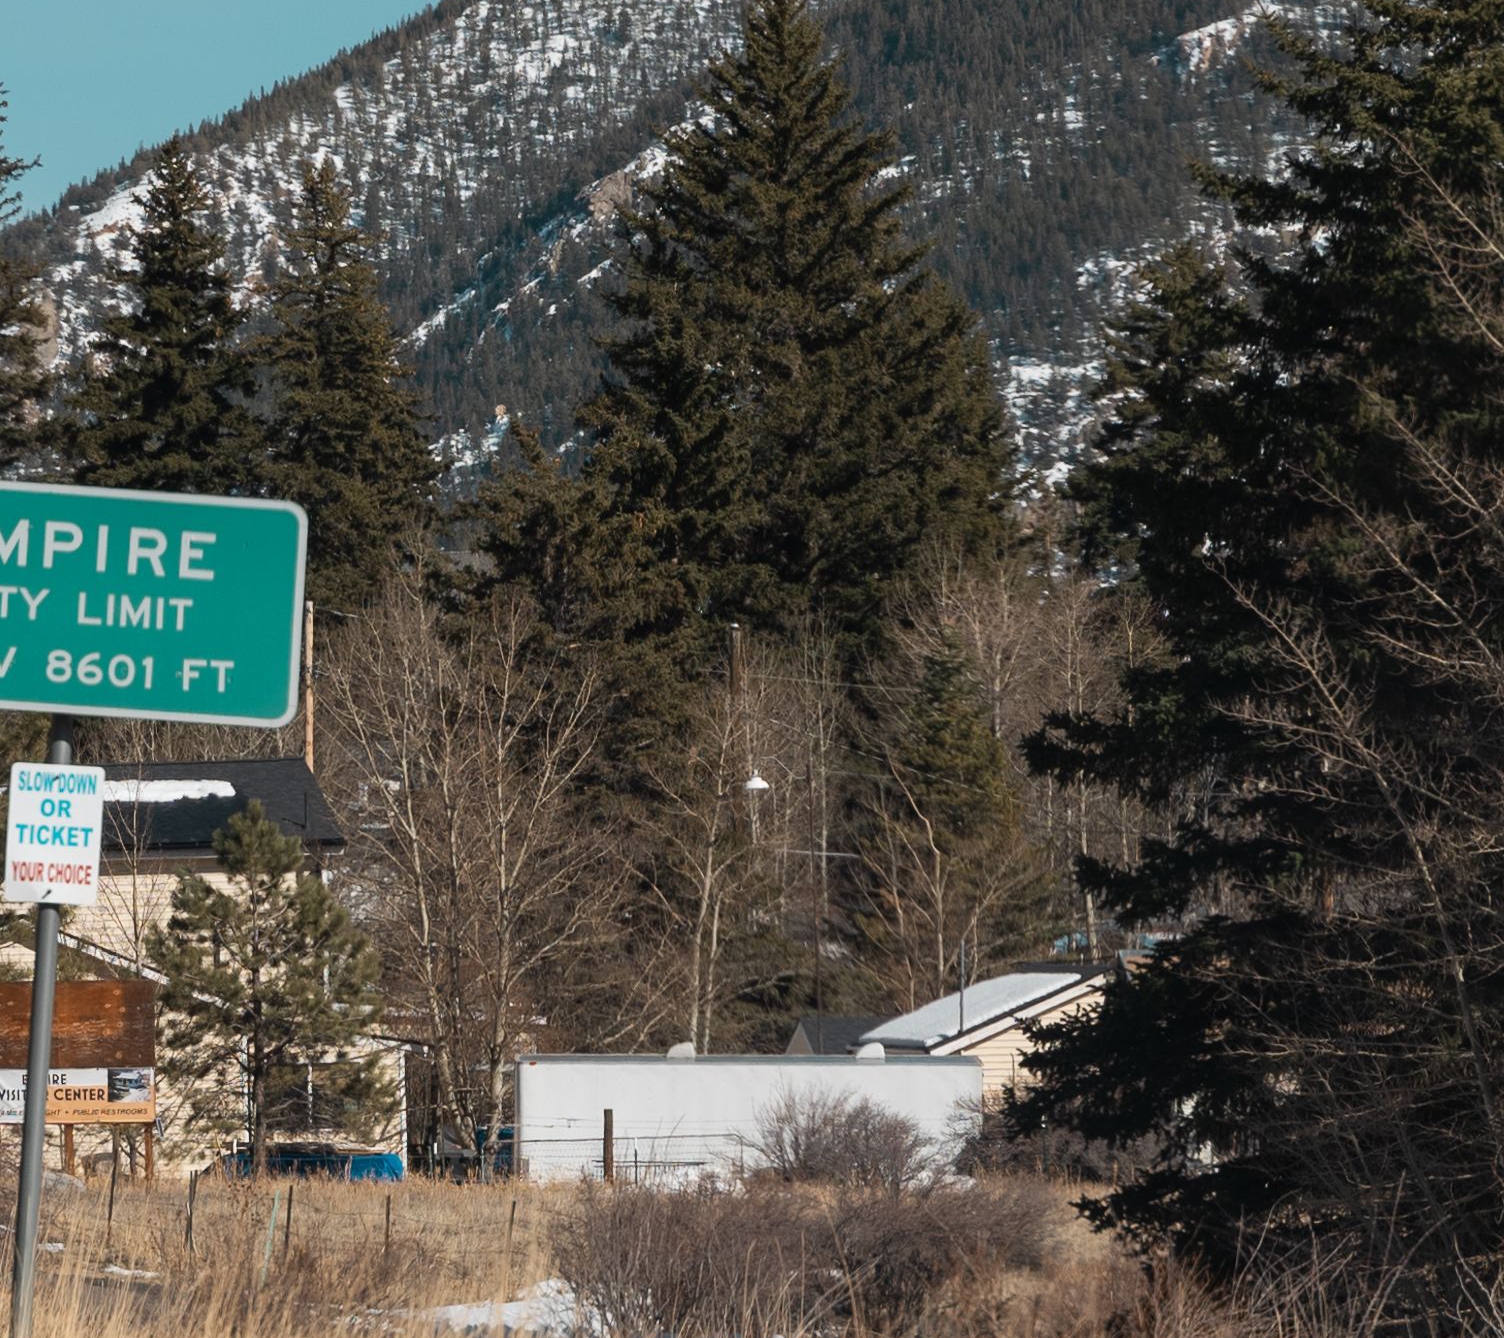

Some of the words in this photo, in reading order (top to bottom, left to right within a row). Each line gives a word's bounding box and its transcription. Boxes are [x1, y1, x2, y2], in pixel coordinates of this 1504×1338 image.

[77, 591, 193, 631] LIMIT
[45, 649, 154, 689] 8601
[182, 658, 234, 693] FT
[18, 770, 54, 792] SLOW
[58, 772, 97, 795] DOWN
[40, 798, 71, 818] OR
[15, 823, 93, 847] TICKET
[12, 861, 44, 882] YOUR
[47, 863, 92, 885] CHOICE
[22, 1074, 67, 1085] EIRE
[53, 1088, 105, 1101] CENTER
